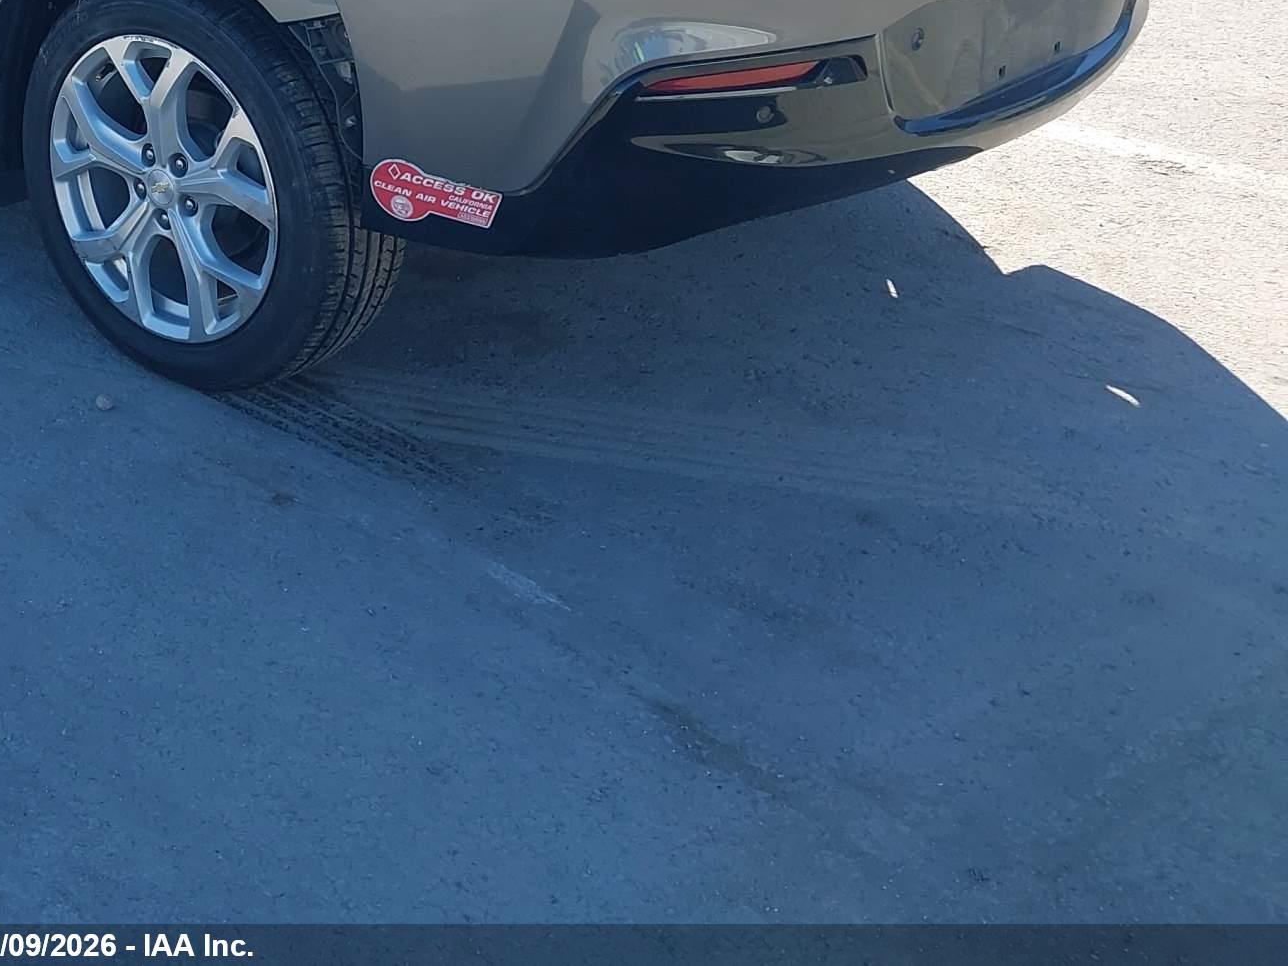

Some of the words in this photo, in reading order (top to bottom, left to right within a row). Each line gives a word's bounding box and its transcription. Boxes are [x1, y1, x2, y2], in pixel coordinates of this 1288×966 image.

[373, 180, 412, 197] CLEAN
[415, 193, 437, 203] AIR
[440, 199, 492, 218] VEHICLE
[400, 172, 467, 196] ACCESS
[470, 190, 497, 204] OK
[448, 195, 493, 211] CALIFORNIA
